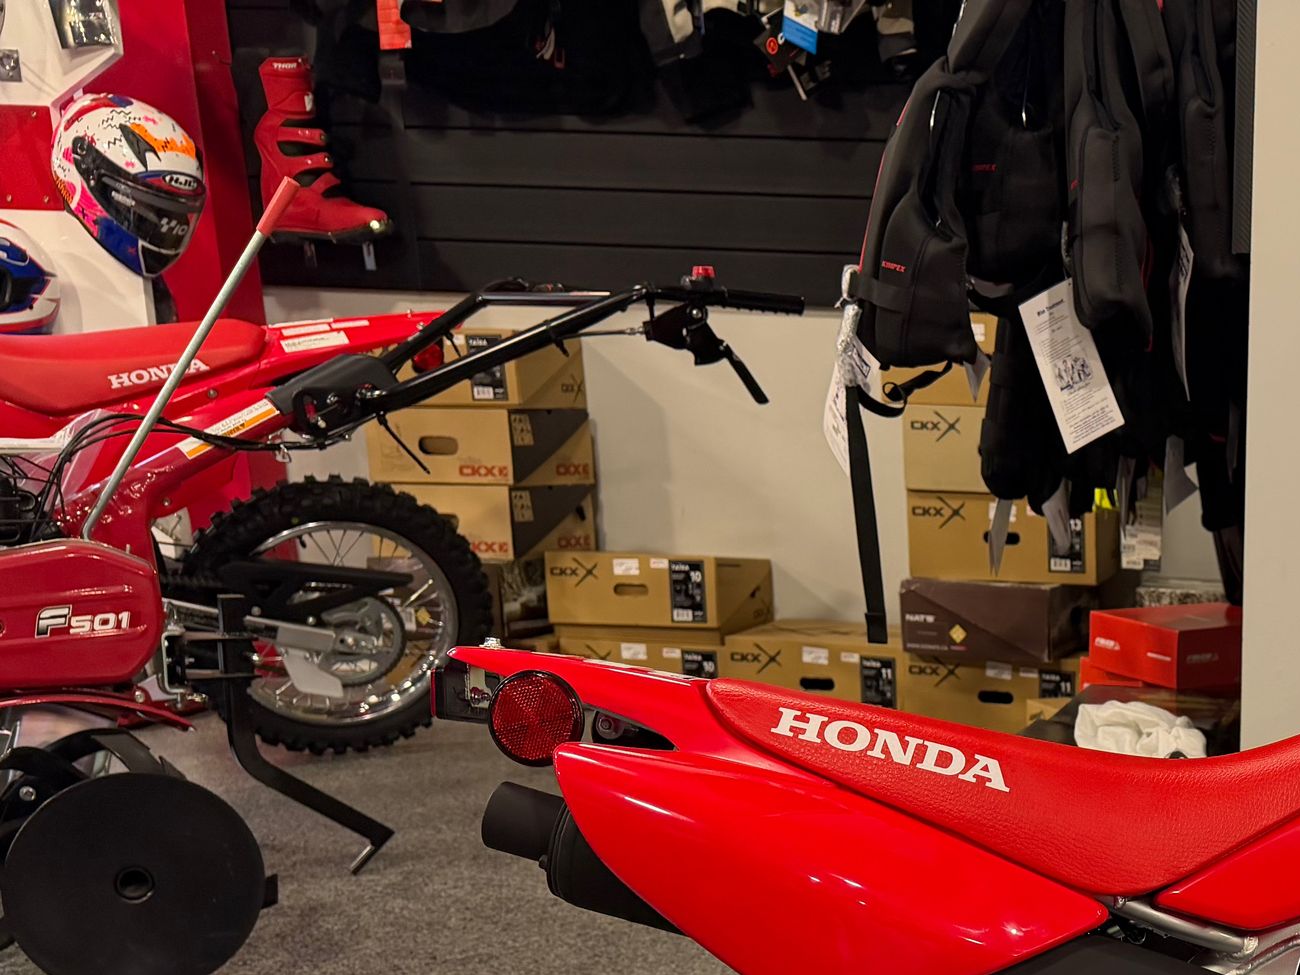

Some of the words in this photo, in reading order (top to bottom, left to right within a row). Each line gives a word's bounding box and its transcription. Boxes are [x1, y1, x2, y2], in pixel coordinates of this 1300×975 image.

[272, 62, 297, 70] THOR
[107, 358, 210, 390] HONA
[689, 570, 702, 583] 10
[35, 604, 131, 639] F501
[770, 706, 1011, 793] HONDA
